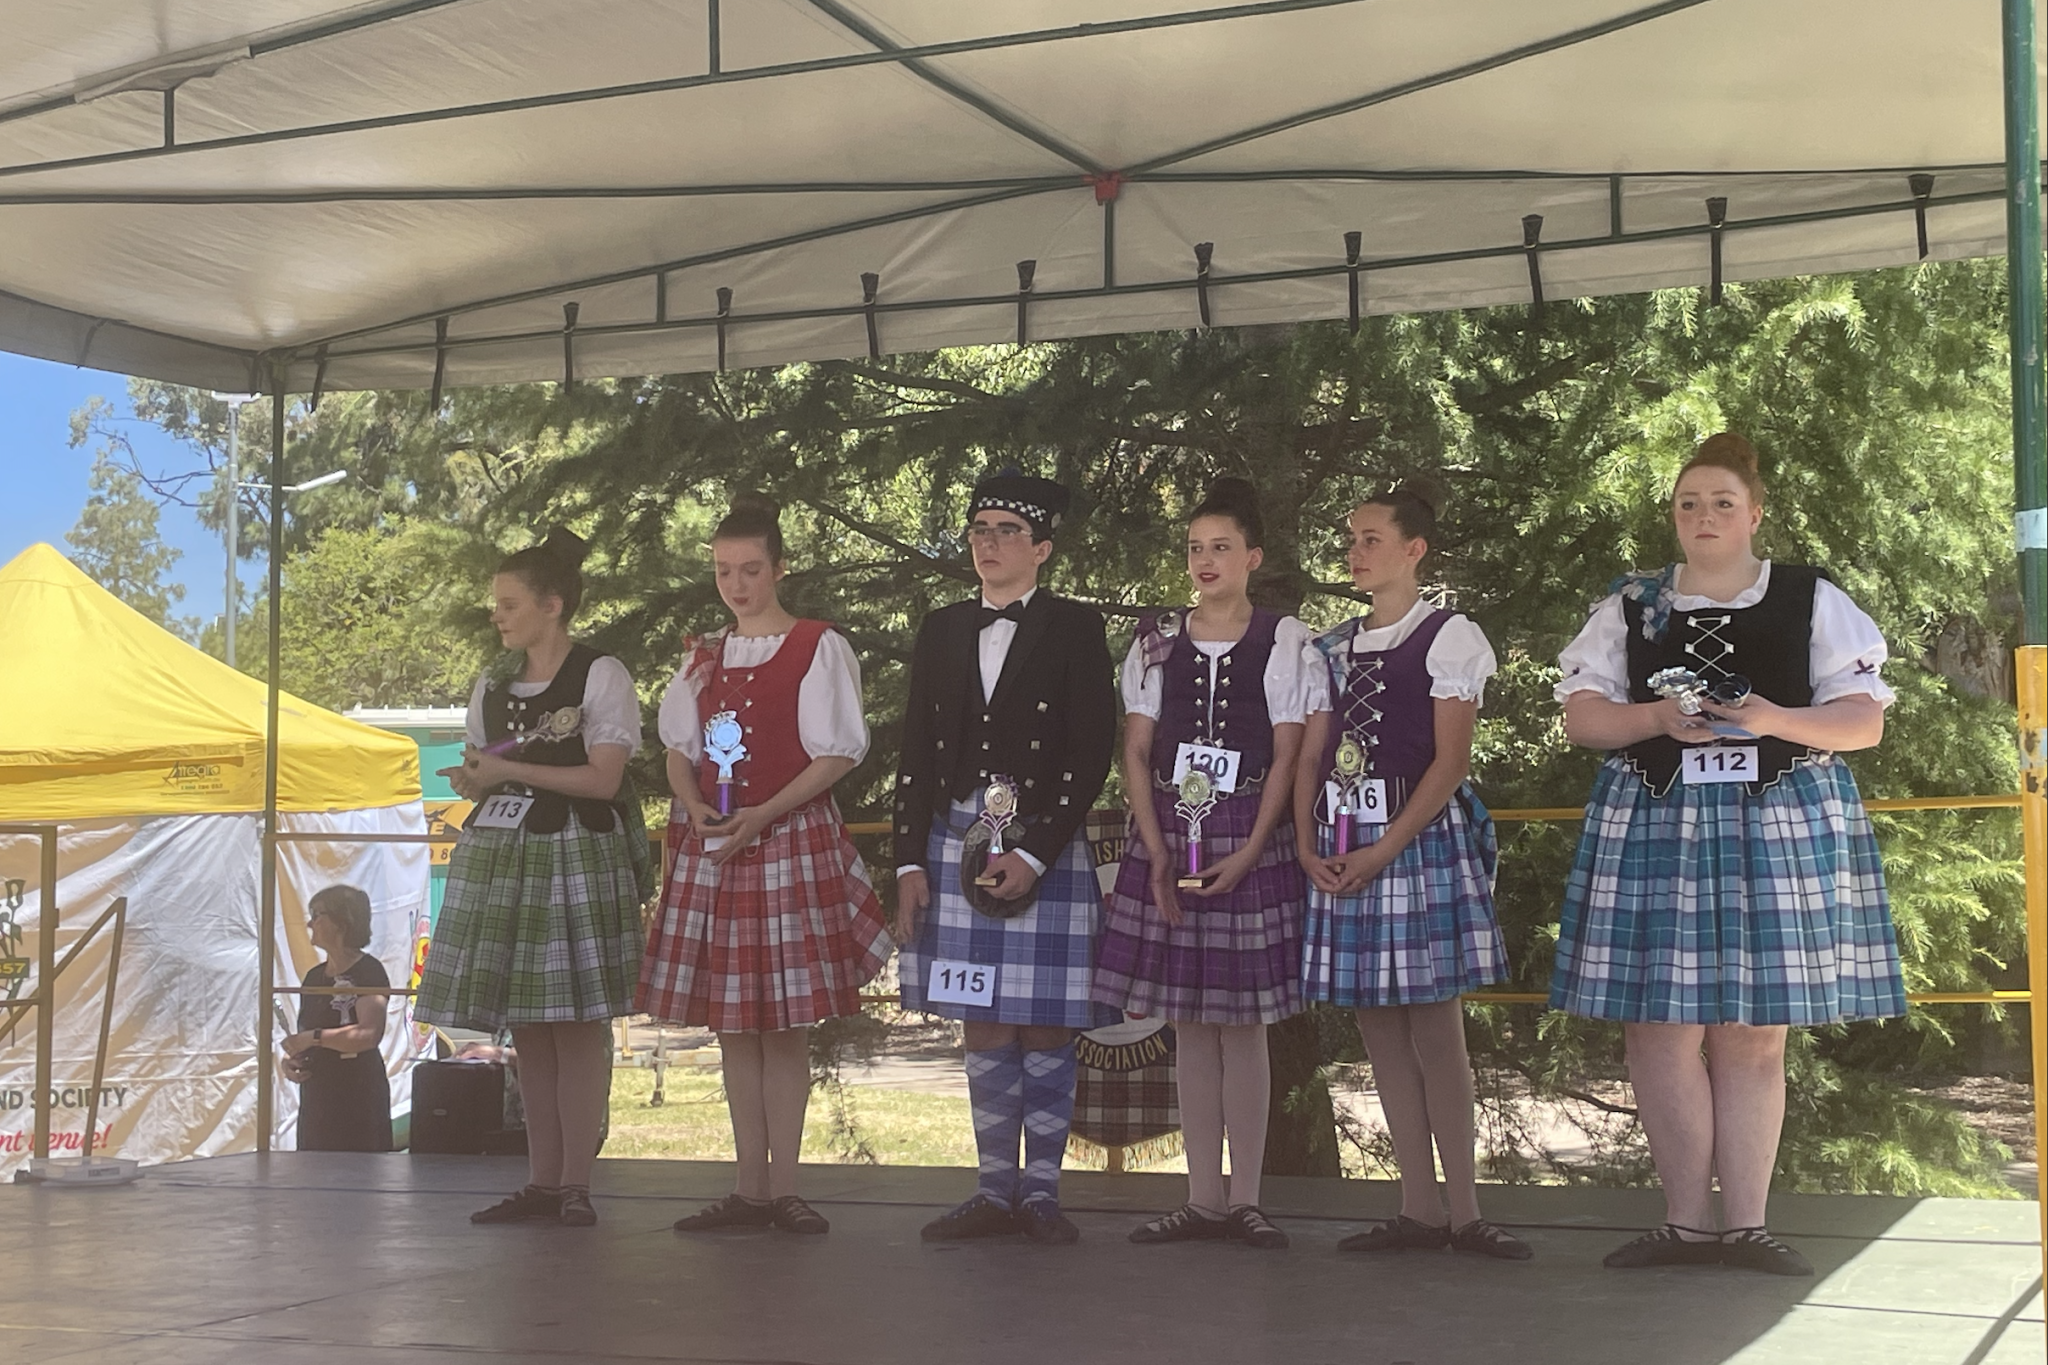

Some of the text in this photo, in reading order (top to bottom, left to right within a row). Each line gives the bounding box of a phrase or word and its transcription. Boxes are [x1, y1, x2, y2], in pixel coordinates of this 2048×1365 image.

[1693, 752, 1747, 772] 112
[1337, 786, 1377, 810] 16
[488, 800, 523, 818] 113
[0, 962, 26, 975] 57
[940, 968, 985, 993] 115
